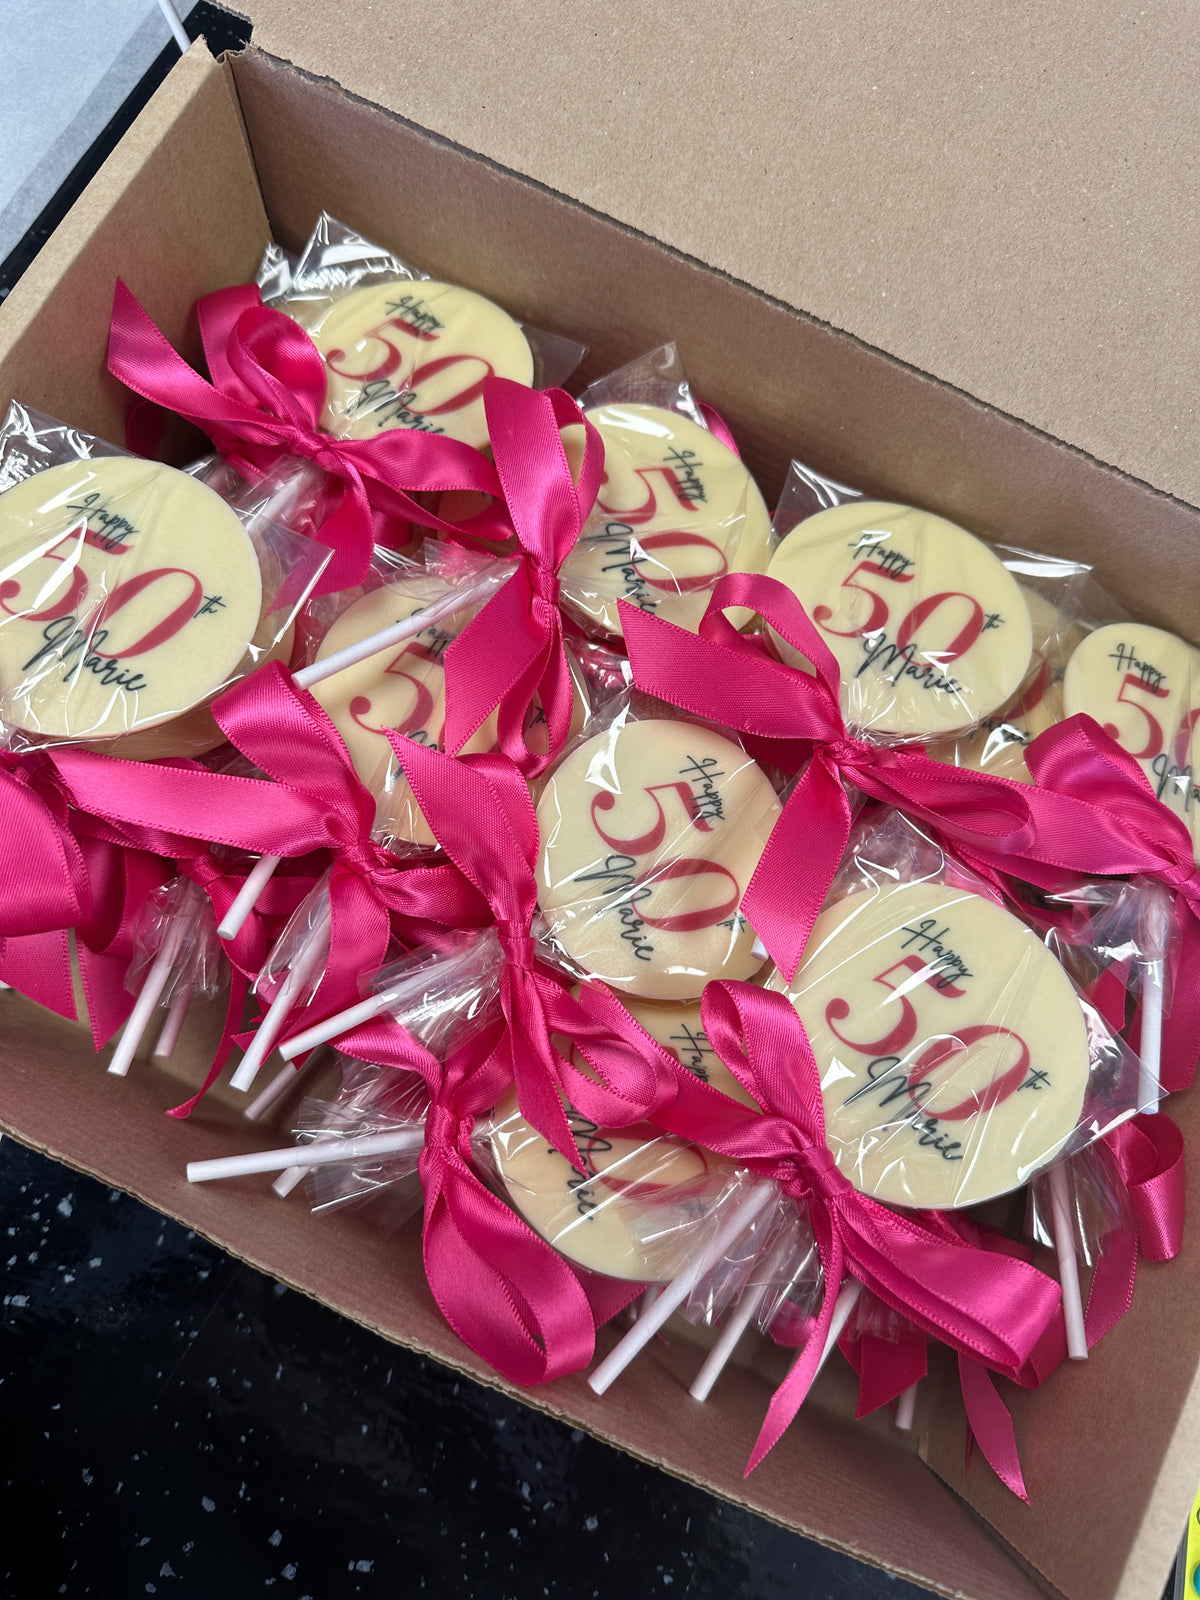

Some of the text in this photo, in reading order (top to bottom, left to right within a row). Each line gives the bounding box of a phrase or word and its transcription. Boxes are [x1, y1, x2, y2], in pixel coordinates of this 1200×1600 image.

[326, 317, 496, 417] 50
[663, 446, 708, 504] Happy
[66, 492, 140, 550] Happy
[596, 466, 729, 593] 50
[848, 533, 916, 579] Happy
[22, 615, 147, 692] Marie
[855, 632, 962, 695] Marie
[1108, 642, 1167, 694] Happy
[679, 754, 726, 821] Happy
[574, 853, 655, 962] Marie
[901, 919, 974, 989] Happy
